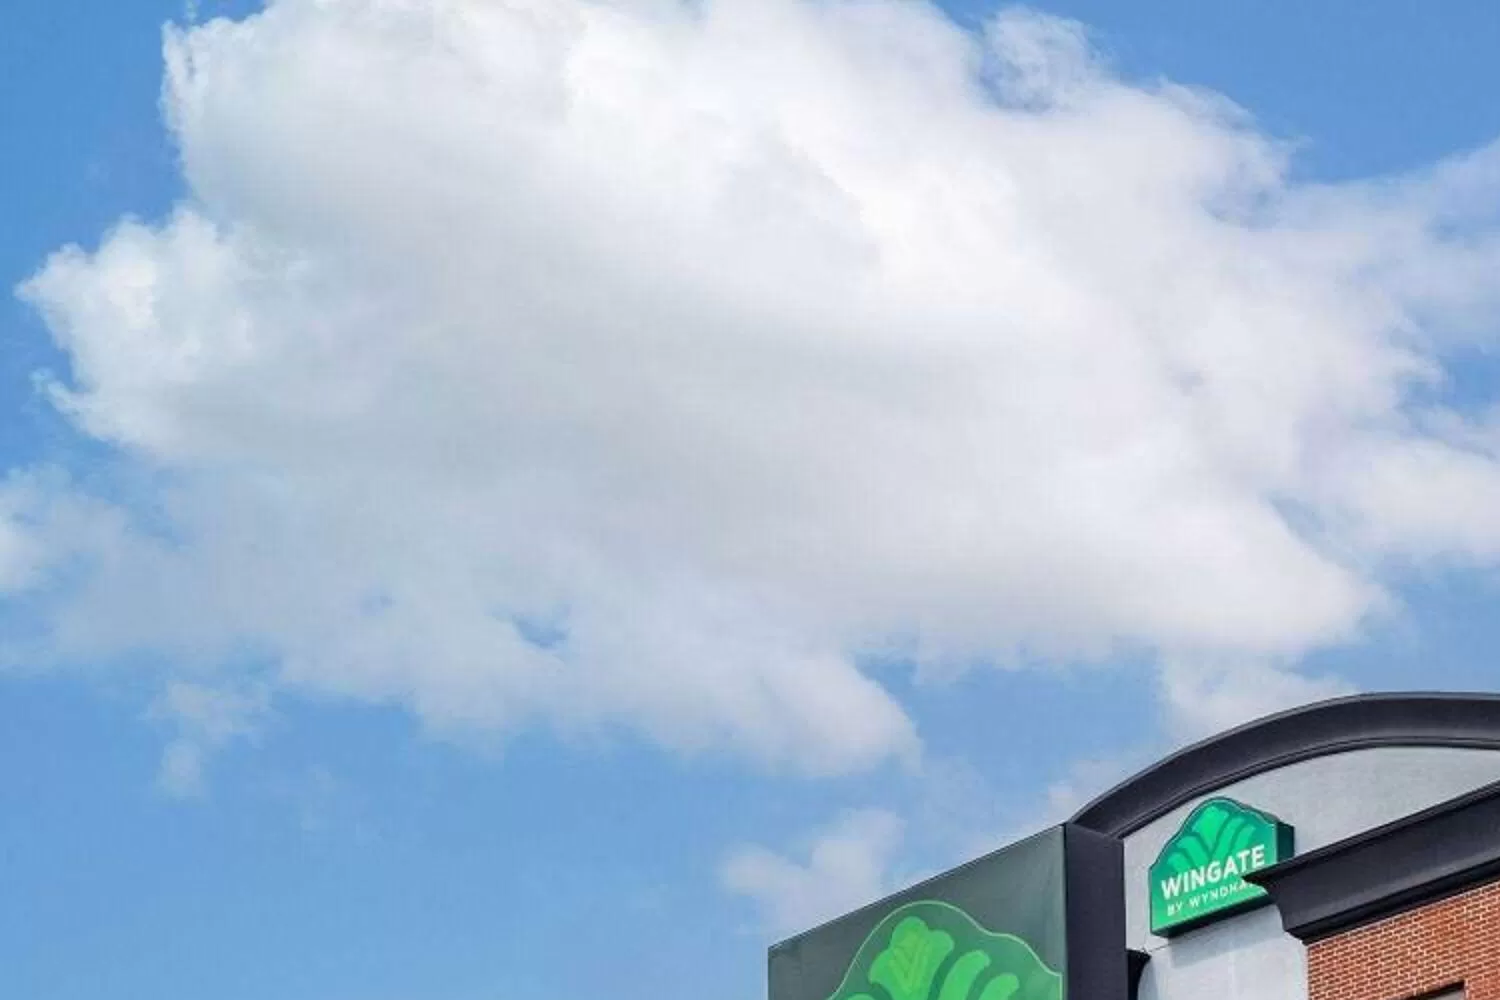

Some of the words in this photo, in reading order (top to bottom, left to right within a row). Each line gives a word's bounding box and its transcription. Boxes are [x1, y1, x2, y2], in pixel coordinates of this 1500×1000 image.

[1161, 844, 1265, 900] WINGATE
[1166, 901, 1183, 917] BY
[1189, 880, 1254, 908] WYNDHA
